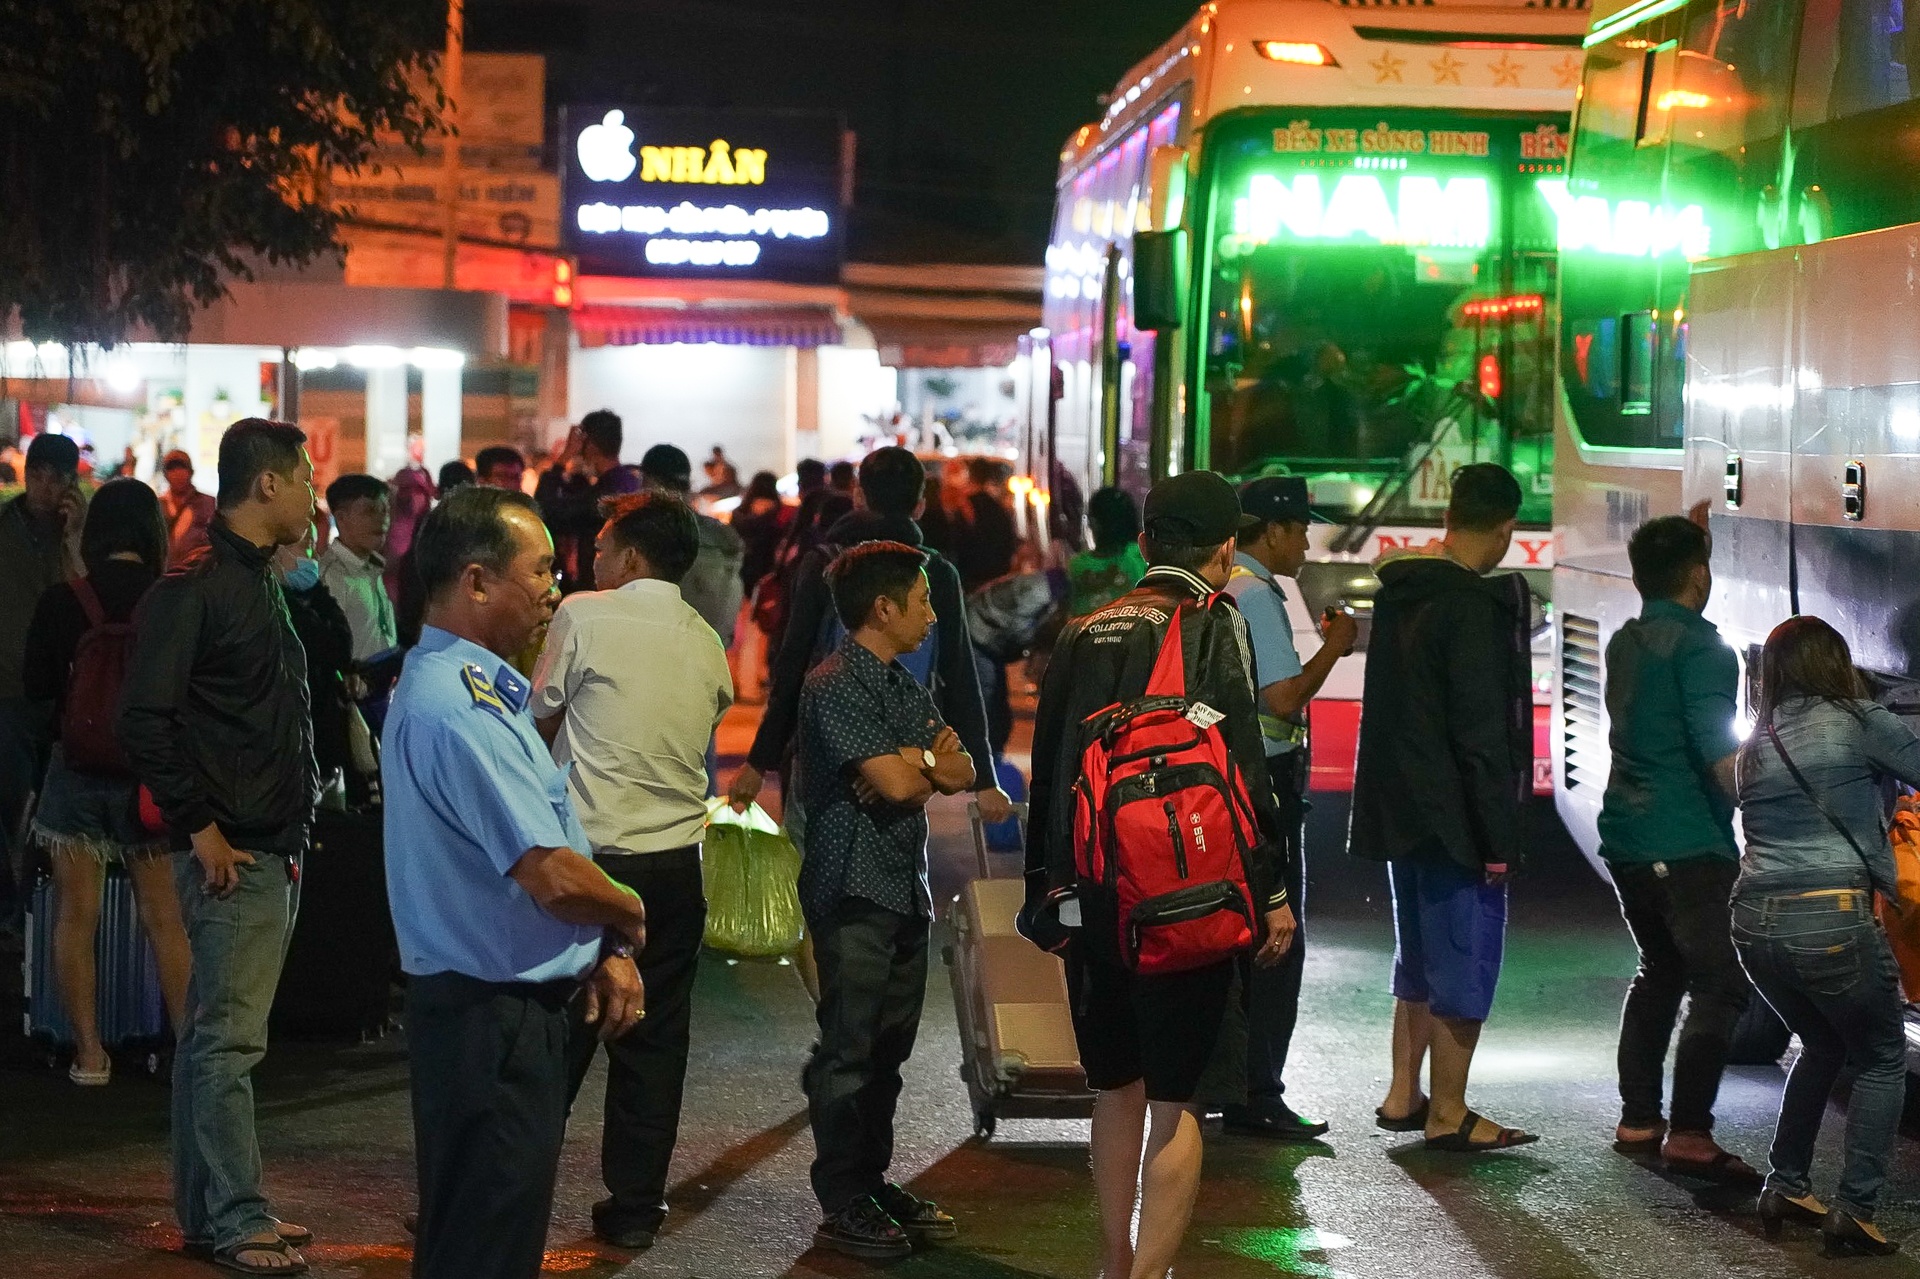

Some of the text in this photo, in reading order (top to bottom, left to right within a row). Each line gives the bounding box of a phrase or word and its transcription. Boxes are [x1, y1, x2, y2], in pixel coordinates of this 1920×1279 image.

[1324, 128, 1358, 151] XE
[1428, 131, 1489, 156] HINH
[640, 138, 768, 185] NHÂN
[1249, 173, 1489, 245] NAM
[1088, 621, 1136, 634] COLLECTION
[1193, 825, 1206, 853] BET
